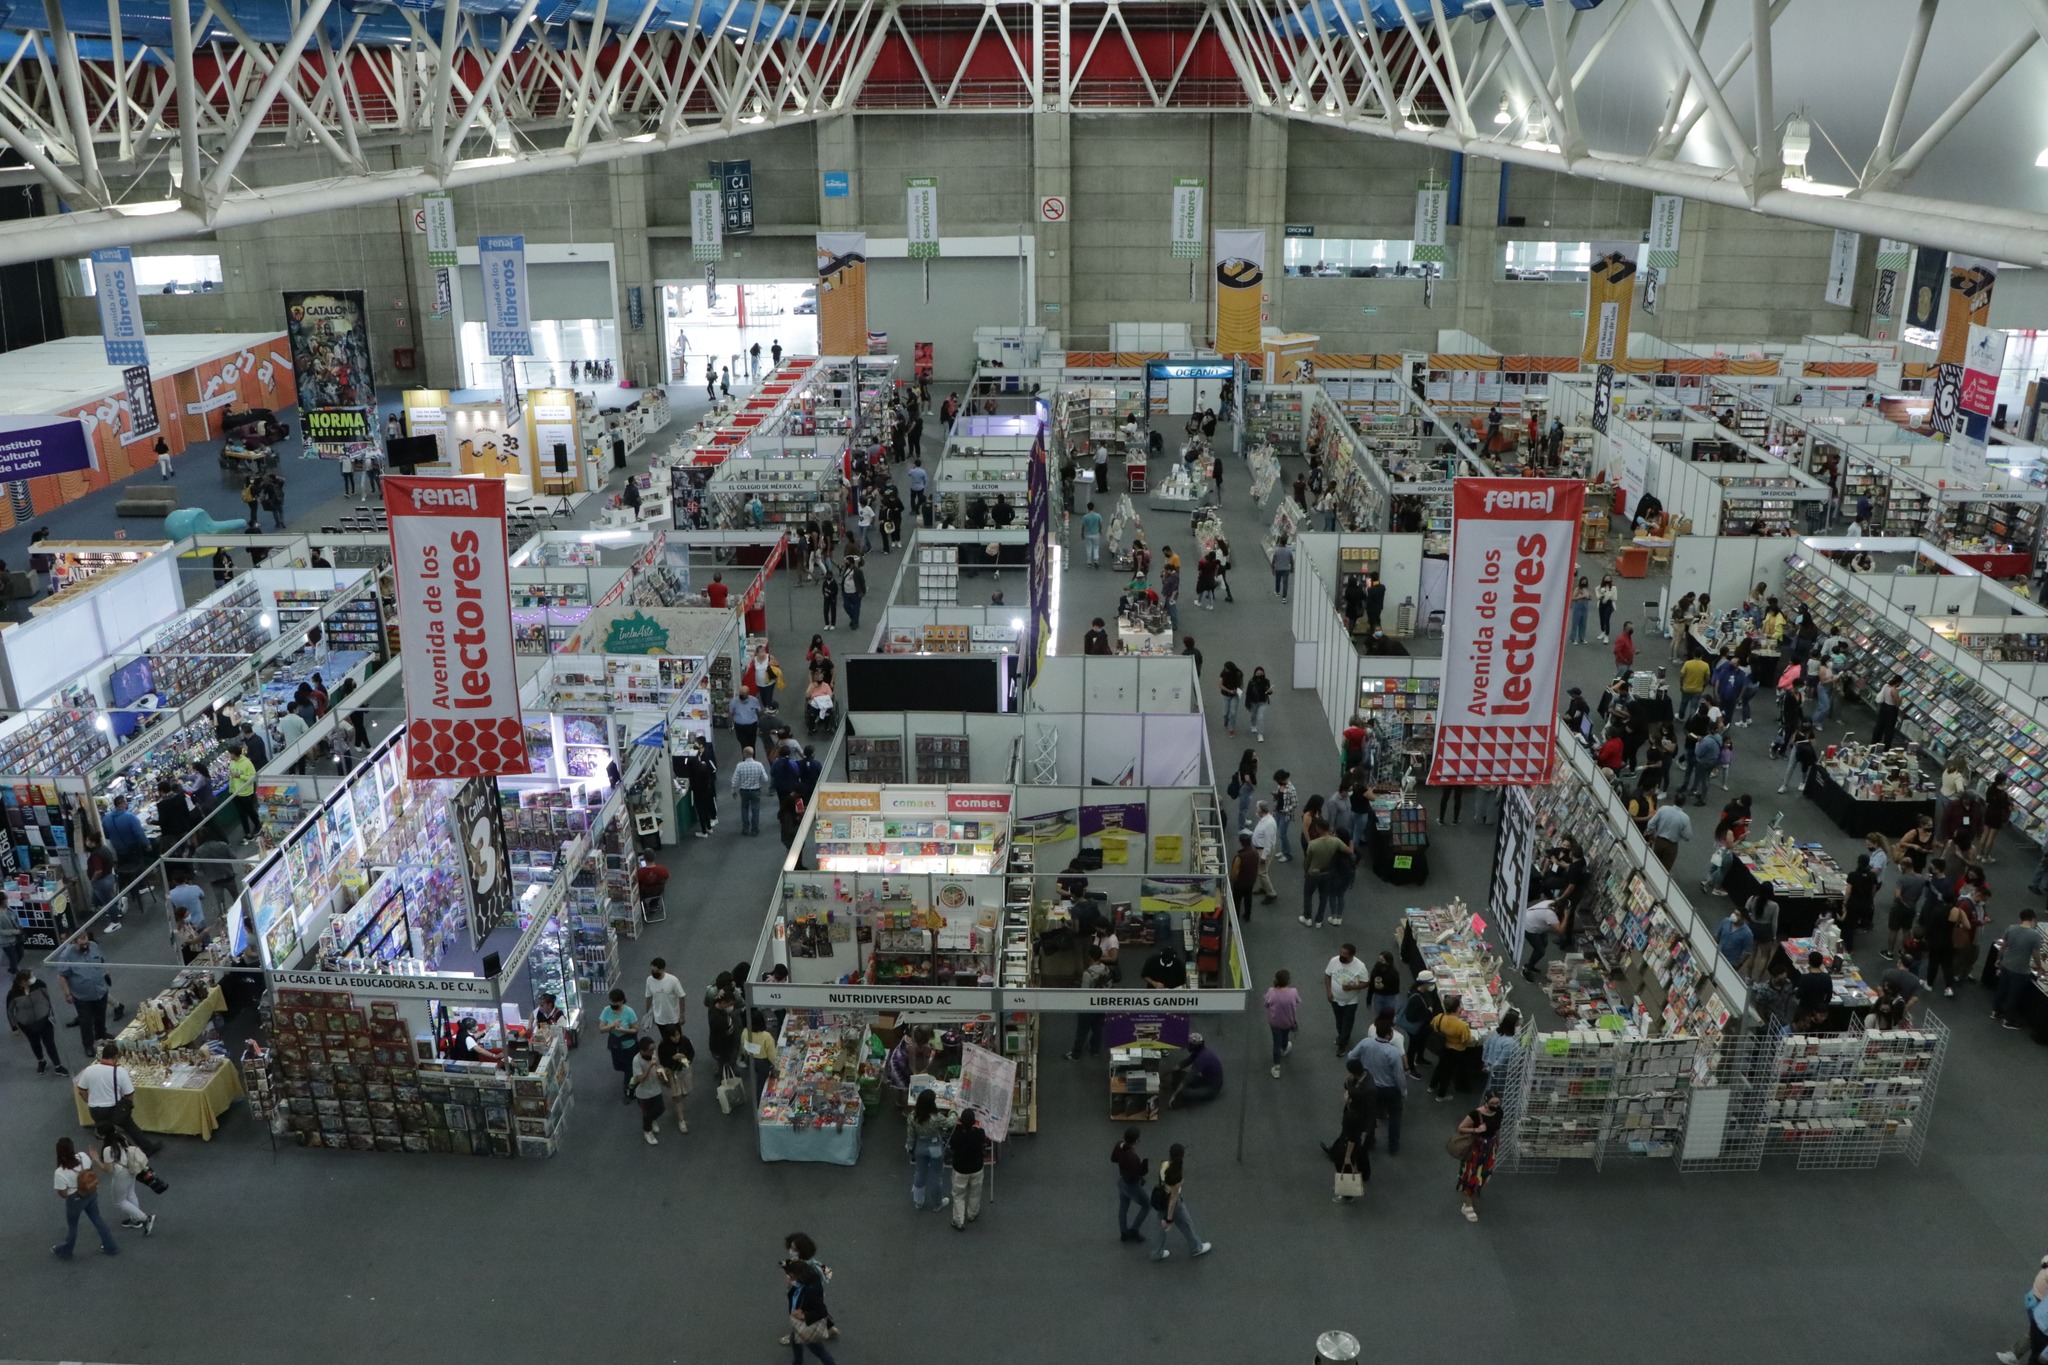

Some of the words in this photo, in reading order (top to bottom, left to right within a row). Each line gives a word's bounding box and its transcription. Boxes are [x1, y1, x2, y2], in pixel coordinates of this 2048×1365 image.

[696, 182, 714, 190] fenal
[732, 178, 743, 189] C4
[913, 178, 930, 186] fenal
[1180, 178, 1197, 186] fenal
[438, 201, 448, 249] escritores
[704, 193, 713, 242] escritores
[921, 190, 931, 239] escritores
[1186, 190, 1196, 239] escritores
[1664, 199, 1676, 248] escritores
[100, 250, 122, 260] fenal
[489, 238, 514, 249] fenal
[105, 273, 113, 287] los
[491, 262, 500, 277] los
[107, 289, 115, 301] de
[492, 279, 500, 290] de
[503, 259, 519, 328] libreros
[114, 270, 134, 337] libreros
[494, 292, 504, 328] Avenida
[110, 302, 121, 338] Avenida
[133, 377, 143, 385] Calle
[134, 387, 148, 416] 1
[1940, 384, 1954, 416] 6
[309, 413, 365, 428] NORMA
[311, 429, 366, 437] Editorial
[316, 443, 345, 455] HULK
[502, 434, 519, 450] 33
[14, 460, 42, 471] León
[412, 484, 478, 511] fenal
[770, 482, 792, 490] MÉXICO
[1484, 486, 1554, 514] fenal
[420, 545, 440, 580] los
[1478, 549, 1501, 584] los
[334, 592, 350, 607] CENTAUROS
[351, 585, 360, 594] VIDEO
[423, 585, 442, 614] de
[1475, 591, 1498, 620] de
[451, 529, 492, 709] lectores
[1491, 533, 1547, 715] lectores
[279, 629, 298, 647] CENTAUROS
[299, 621, 310, 632] VIDEO
[426, 620, 450, 710] Avenida
[1468, 627, 1494, 717] Avenida
[208, 678, 231, 700] CENTAUROS
[231, 669, 244, 682] VIDEO
[120, 737, 149, 764] CENTAUROS
[150, 728, 164, 743] VIDEO
[468, 795, 485, 823] Calle
[470, 816, 496, 894] 3
[502, 970, 511, 982] LA
[508, 956, 519, 972] CASA
[525, 907, 550, 944] EDUCADORA
[551, 891, 559, 901] DE
[273, 974, 286, 983] LA
[289, 975, 316, 985] CASA
[318, 976, 332, 985] DE
[335, 976, 348, 987] LA
[350, 978, 416, 990] EDUCADORA
[419, 980, 439, 990] S.A.
[441, 981, 456, 991] DE
[458, 982, 477, 992] C.V.
[829, 994, 933, 1005] NUTRIDIVERSIDAD
[936, 994, 951, 1005] AC
[1090, 996, 1149, 1007] LIBRERIAS
[1152, 996, 1199, 1007] GANDHI
